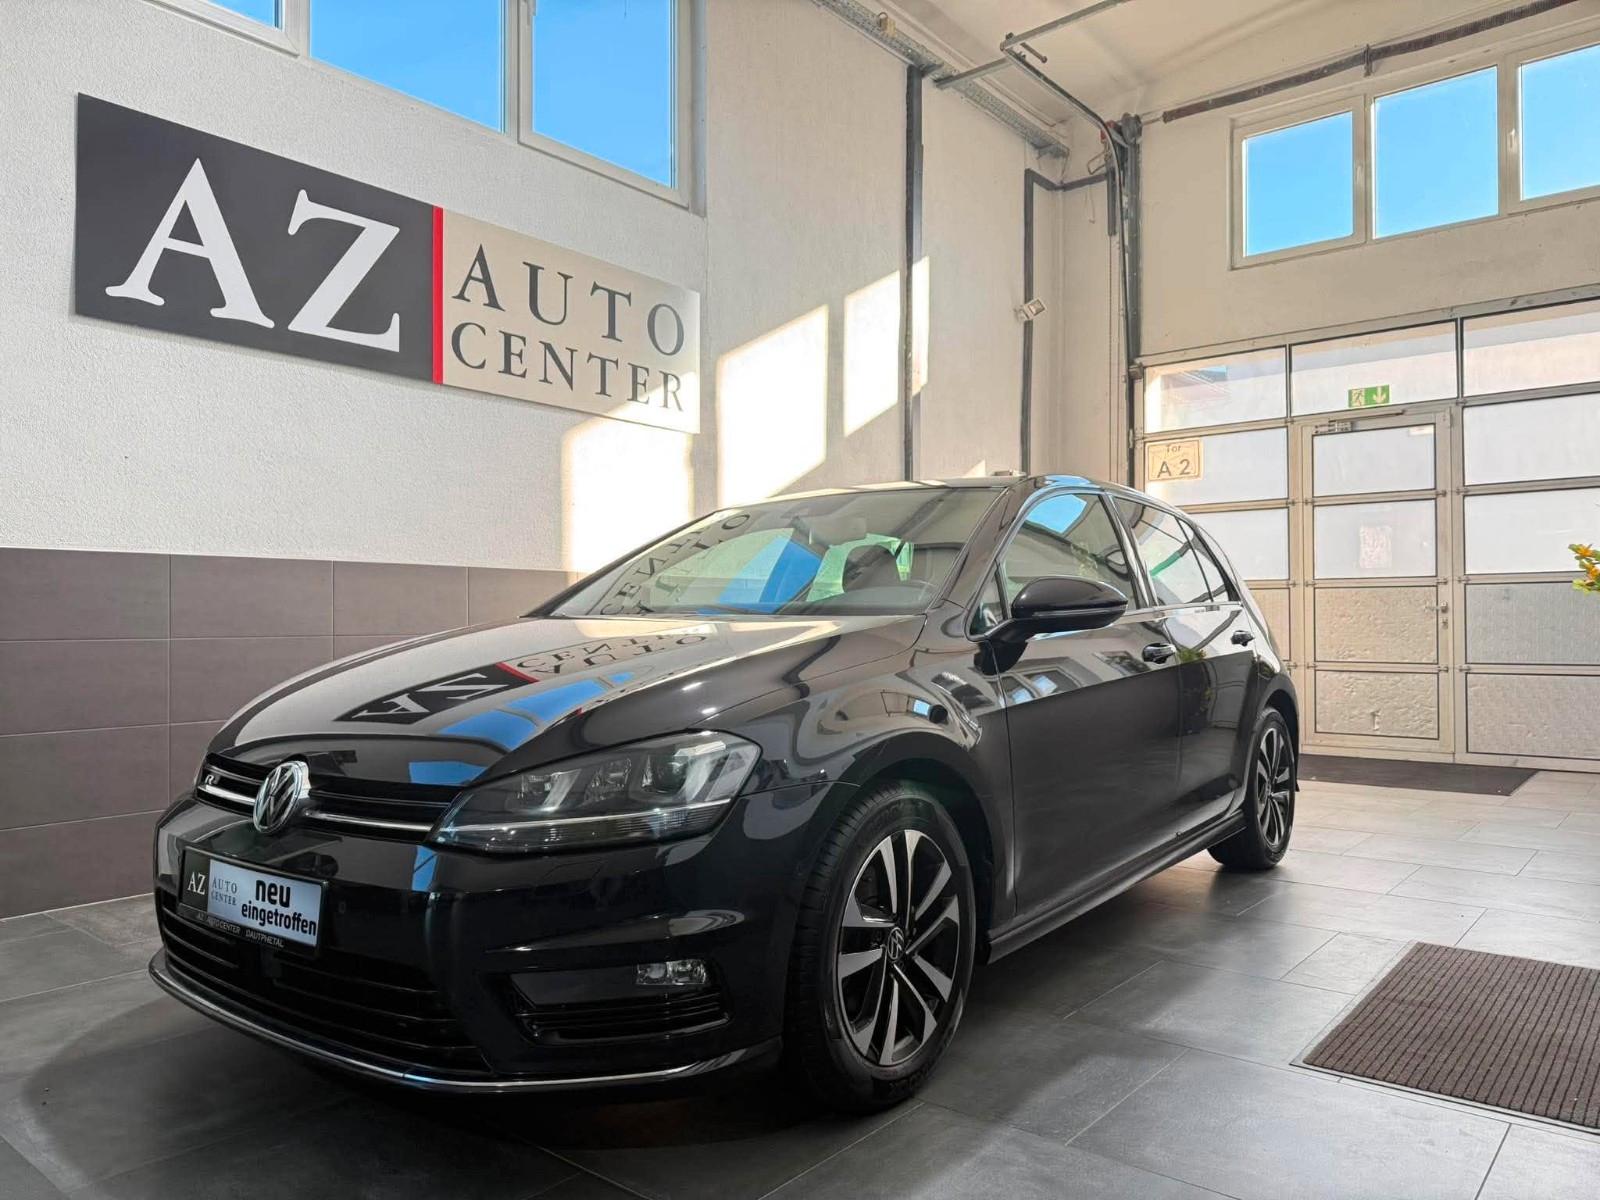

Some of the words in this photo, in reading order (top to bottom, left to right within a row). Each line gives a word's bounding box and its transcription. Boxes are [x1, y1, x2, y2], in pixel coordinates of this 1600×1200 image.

[105, 158, 400, 353] AZ
[451, 243, 685, 357] AUTO
[451, 322, 685, 413] CENTER
[1157, 460, 1172, 478] A
[1179, 458, 1191, 475] 2
[187, 871, 207, 895] AZ
[212, 877, 238, 894] AUTO
[255, 879, 291, 908] neu
[211, 891, 237, 906] CENTER
[241, 900, 317, 936] eingetroffen
